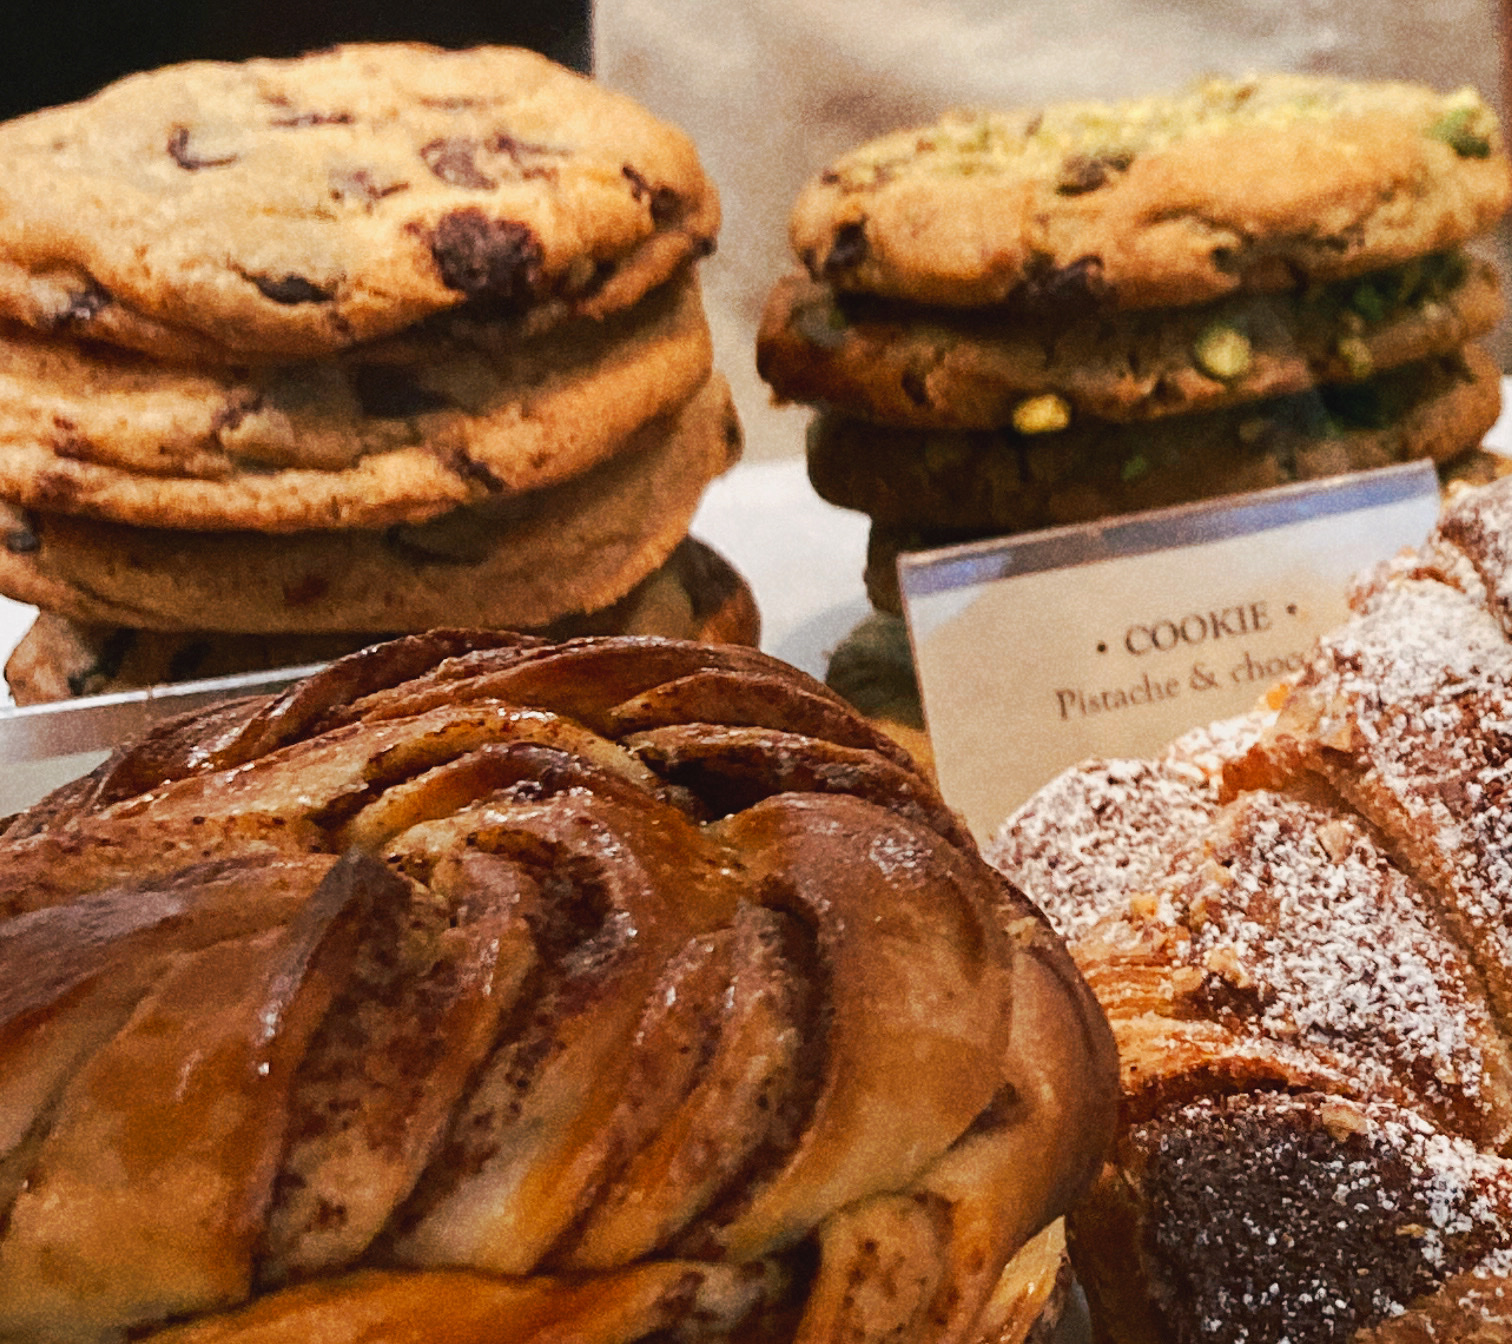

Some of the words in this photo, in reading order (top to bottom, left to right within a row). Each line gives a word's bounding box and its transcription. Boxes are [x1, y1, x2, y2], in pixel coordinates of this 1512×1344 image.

[1125, 600, 1272, 656] COOKIE
[1055, 672, 1180, 721] Pistache
[1189, 663, 1220, 692] &
